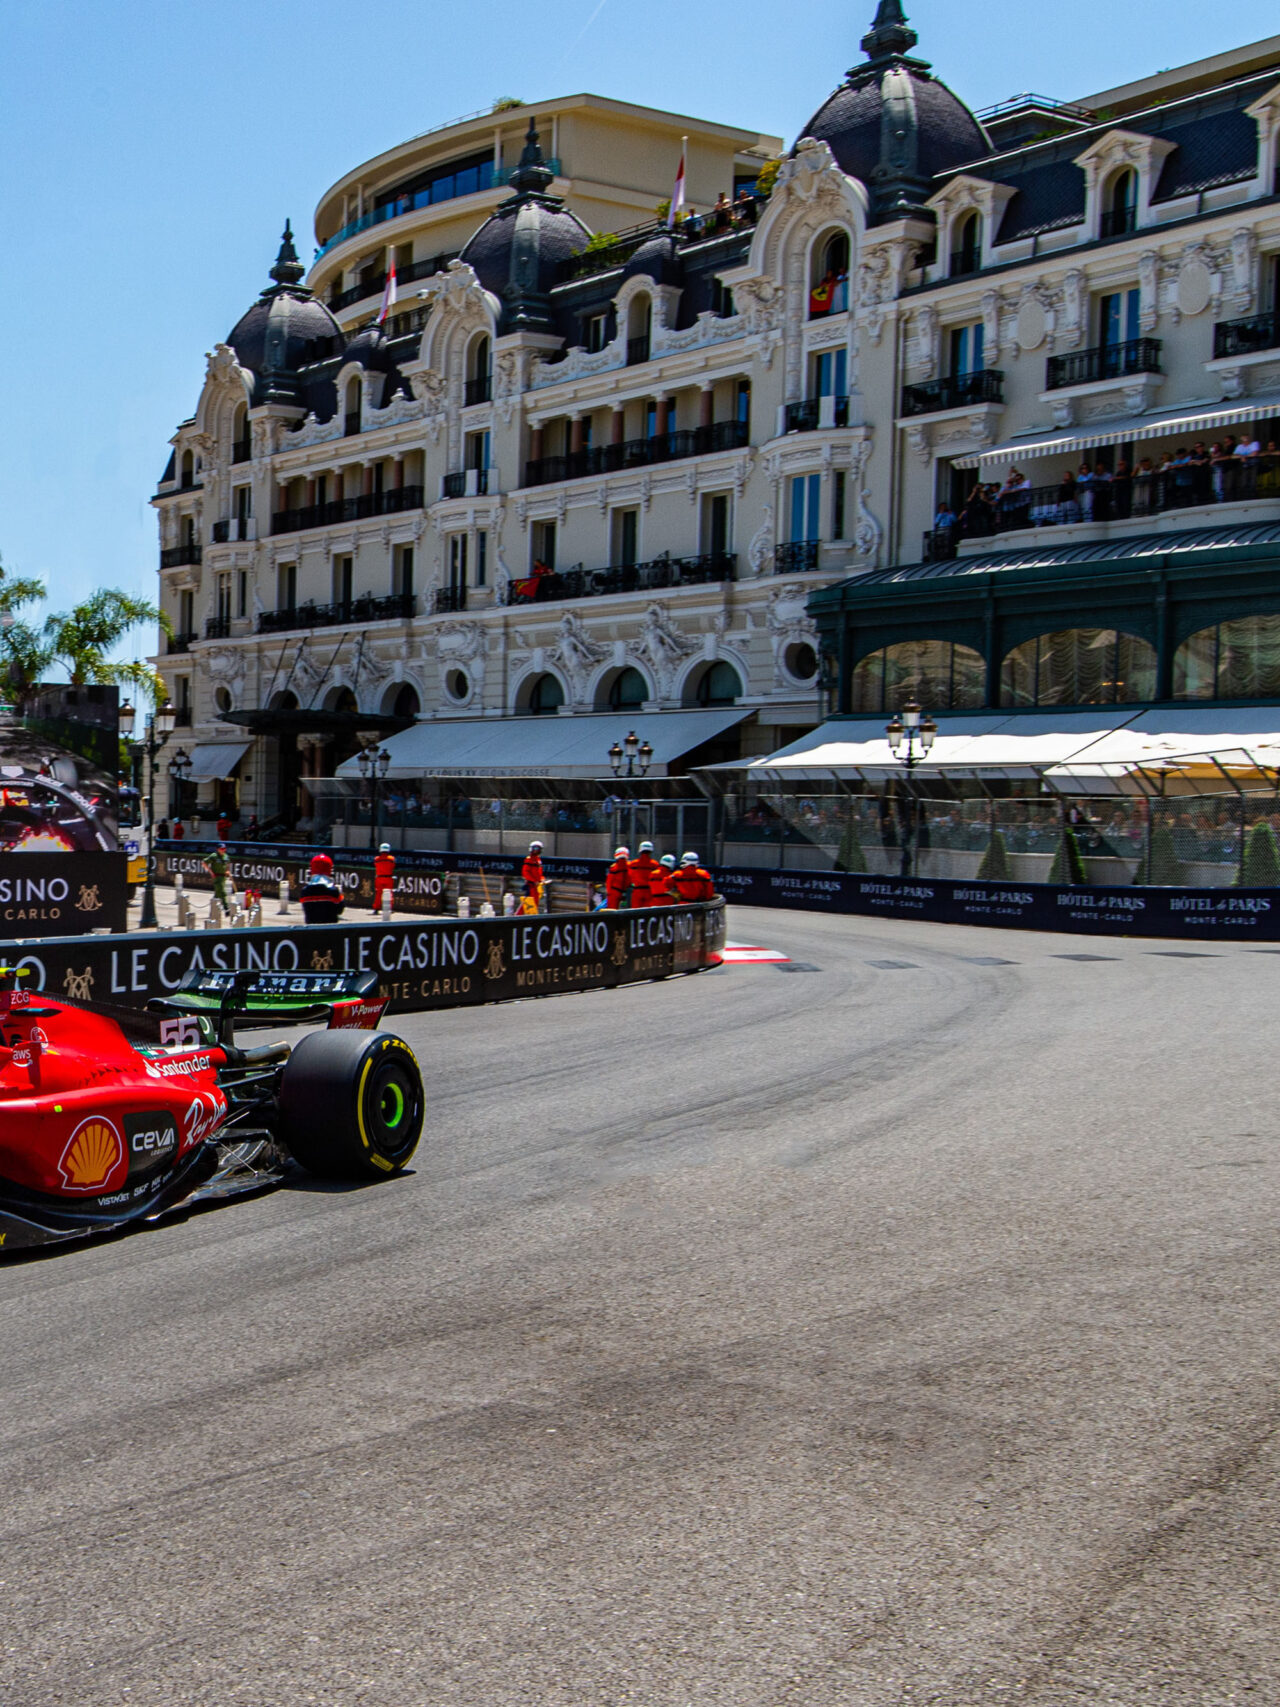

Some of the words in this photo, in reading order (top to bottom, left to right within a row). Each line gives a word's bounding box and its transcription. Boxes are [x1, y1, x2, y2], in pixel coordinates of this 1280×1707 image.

[167, 857, 178, 872] LE
[179, 859, 212, 874] CASIN
[241, 863, 285, 882] CASINO
[812, 880, 841, 891] PARIS
[902, 886, 934, 898] PARIS
[999, 891, 1033, 904] PARIS
[1108, 896, 1145, 910] PARIS
[1228, 898, 1270, 912] PARIS
[511, 927, 532, 960] LE
[536, 921, 609, 958] CASINO
[629, 918, 645, 949] LE
[343, 936, 372, 971] LE
[378, 929, 480, 971] CASINO
[111, 949, 148, 994] LE
[158, 938, 299, 988] CASINO
[10, 992, 30, 1005] ZCG
[160, 1015, 200, 1055] 55
[12, 1049, 32, 1060] aws
[154, 1054, 210, 1077] Santander
